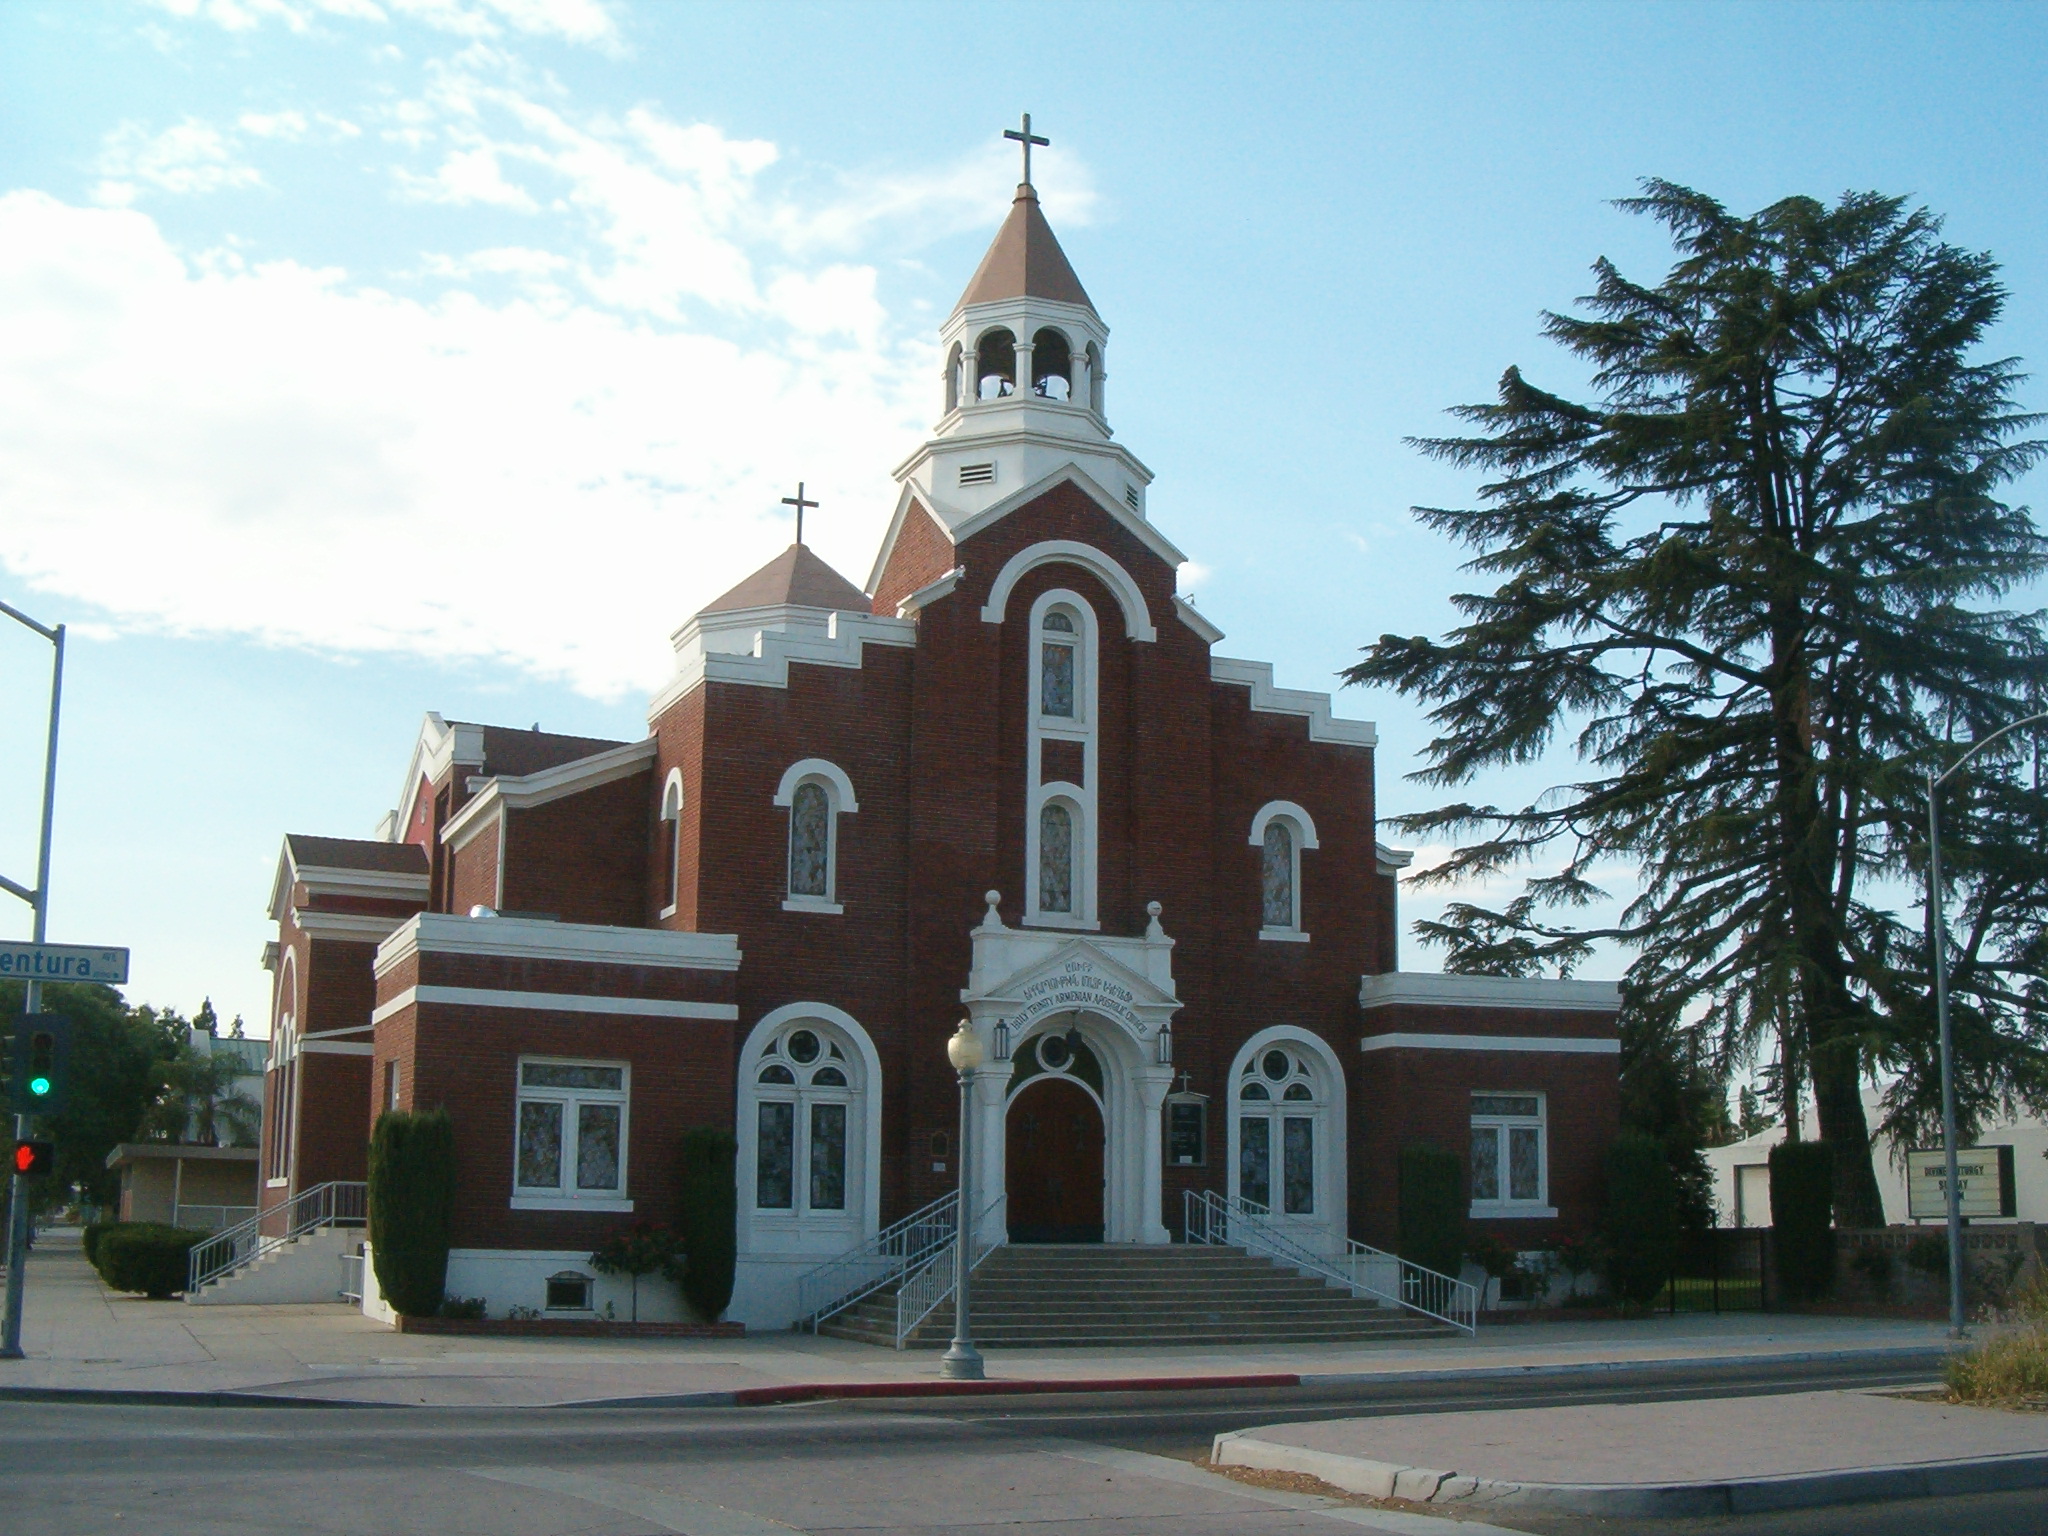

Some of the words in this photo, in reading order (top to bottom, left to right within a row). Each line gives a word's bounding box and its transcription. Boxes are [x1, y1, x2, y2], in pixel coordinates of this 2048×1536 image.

[1011, 1011, 1030, 1031] HOLY
[1026, 996, 1054, 1015] TRINITY
[1054, 991, 1093, 1004] ARMENIAN
[1093, 994, 1128, 1016] APOSTOLIC
[1125, 1010, 1148, 1035] CHURCH
